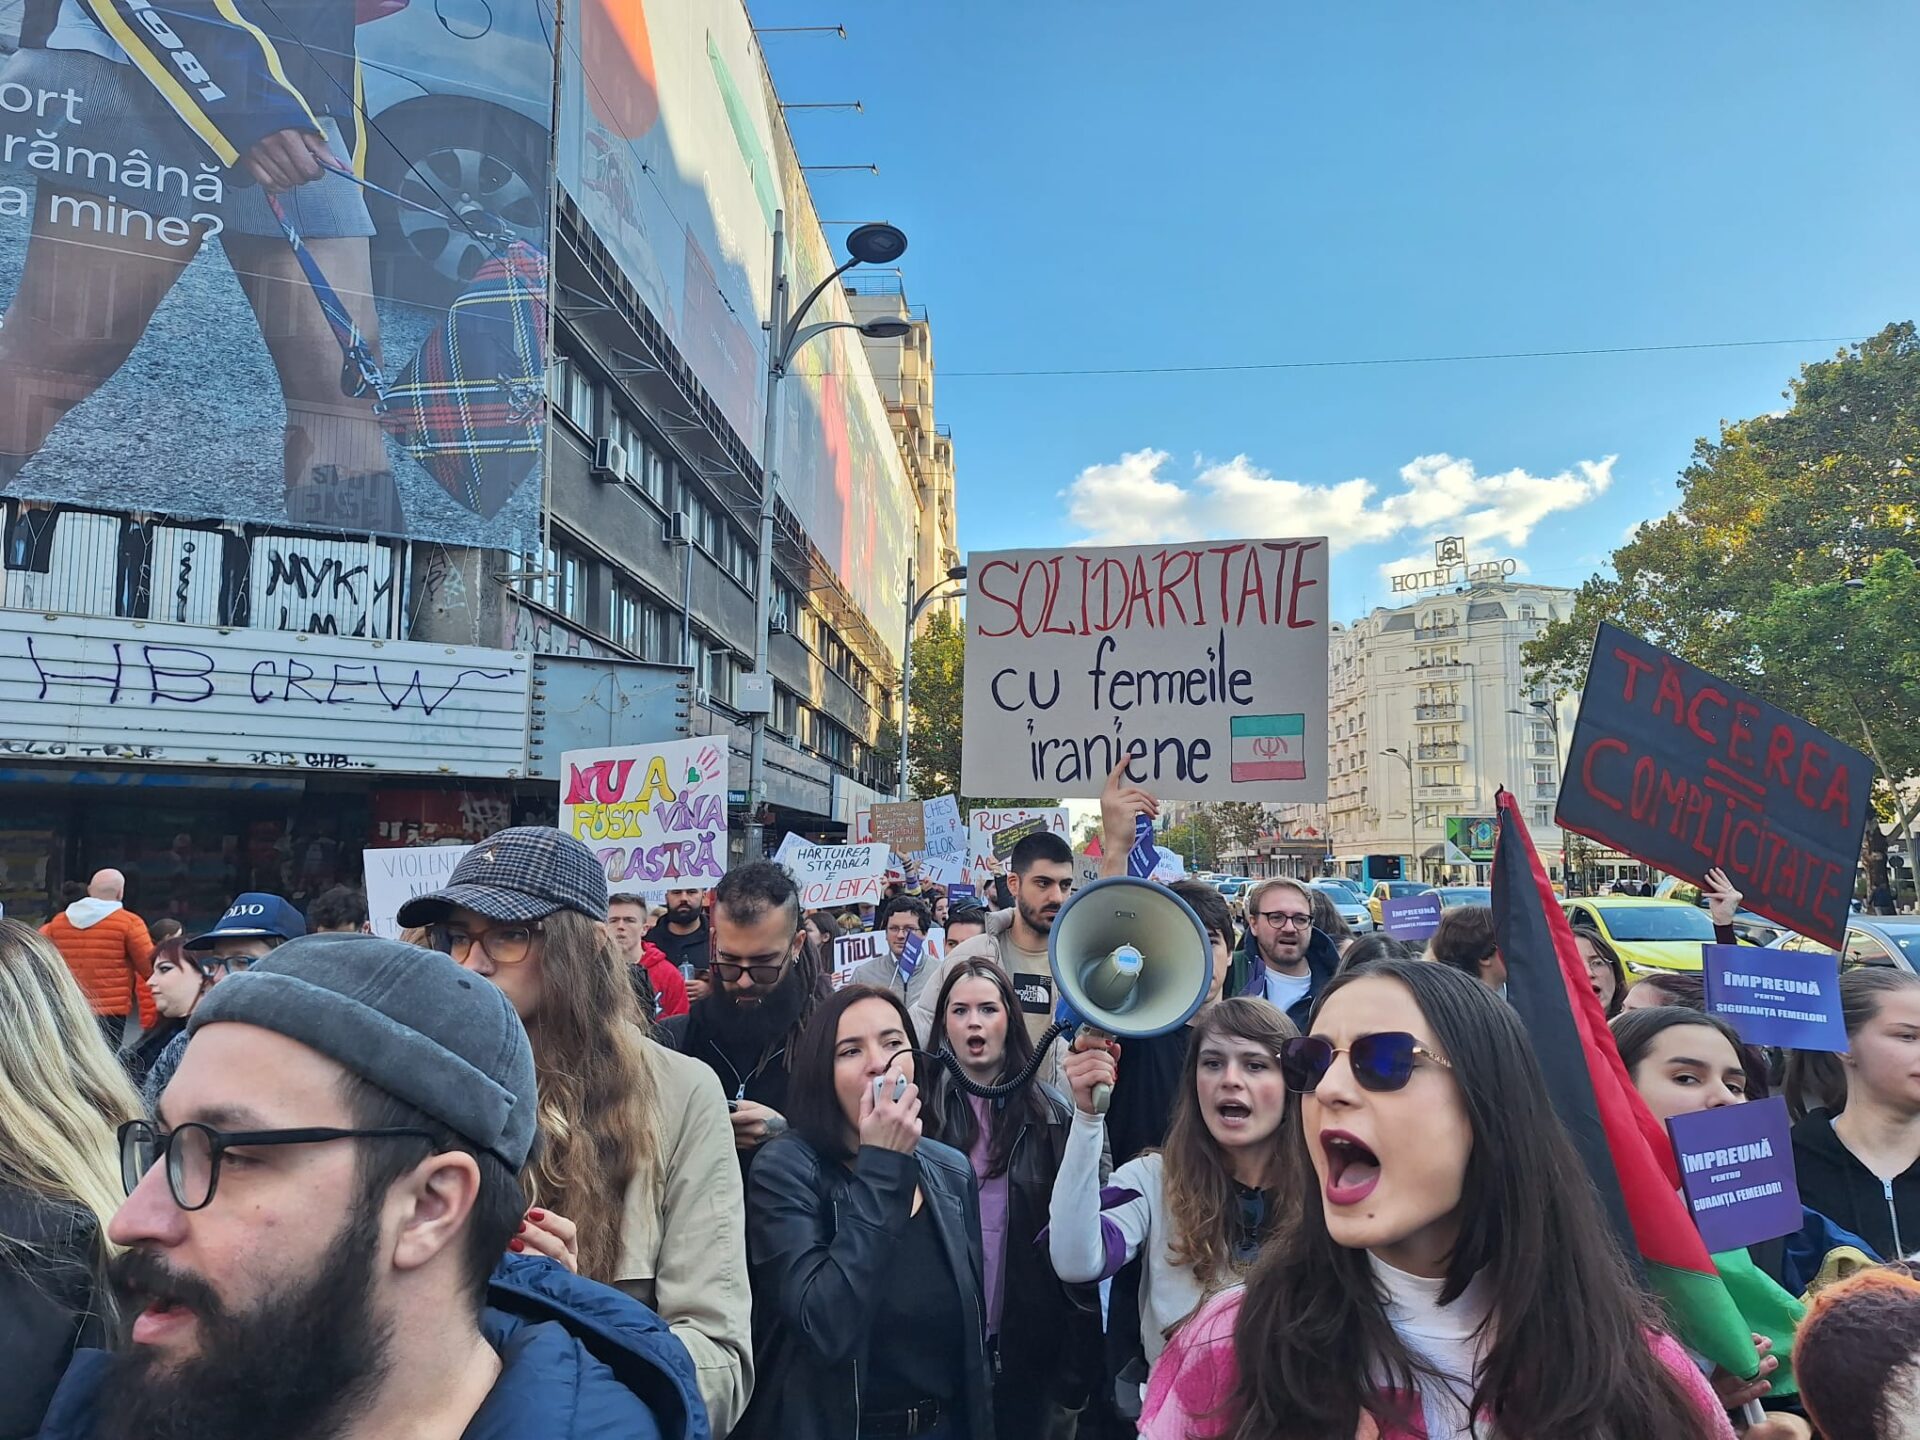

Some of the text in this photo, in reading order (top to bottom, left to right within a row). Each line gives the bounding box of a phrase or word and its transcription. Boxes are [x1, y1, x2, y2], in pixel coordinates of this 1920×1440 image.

[125, 0, 226, 102] 981
[4, 128, 224, 204] rămână
[50, 194, 225, 251] mine?
[978, 541, 1322, 638] SOLIDARITATE
[1391, 568, 1459, 593] HOTEL
[1088, 626, 1254, 711] femeile
[1027, 715, 1212, 783] iraniene
[564, 755, 678, 805] NU A
[571, 799, 650, 841] FOST
[1582, 737, 1843, 929] COMPLICITATE
[382, 851, 466, 878] VIOLENT
[222, 903, 265, 920] OLVO
[1722, 971, 1821, 996] ÎMPREUNĂ
[1753, 992, 1786, 1002] PENTRU
[1715, 1003, 1777, 1018] SIGURANȚA
[1681, 1137, 1774, 1174] ÎMPREUNĂ
[1710, 1170, 1741, 1183] PENTRU
[1693, 1181, 1783, 1212] GURANȚA FEMEILOR!
